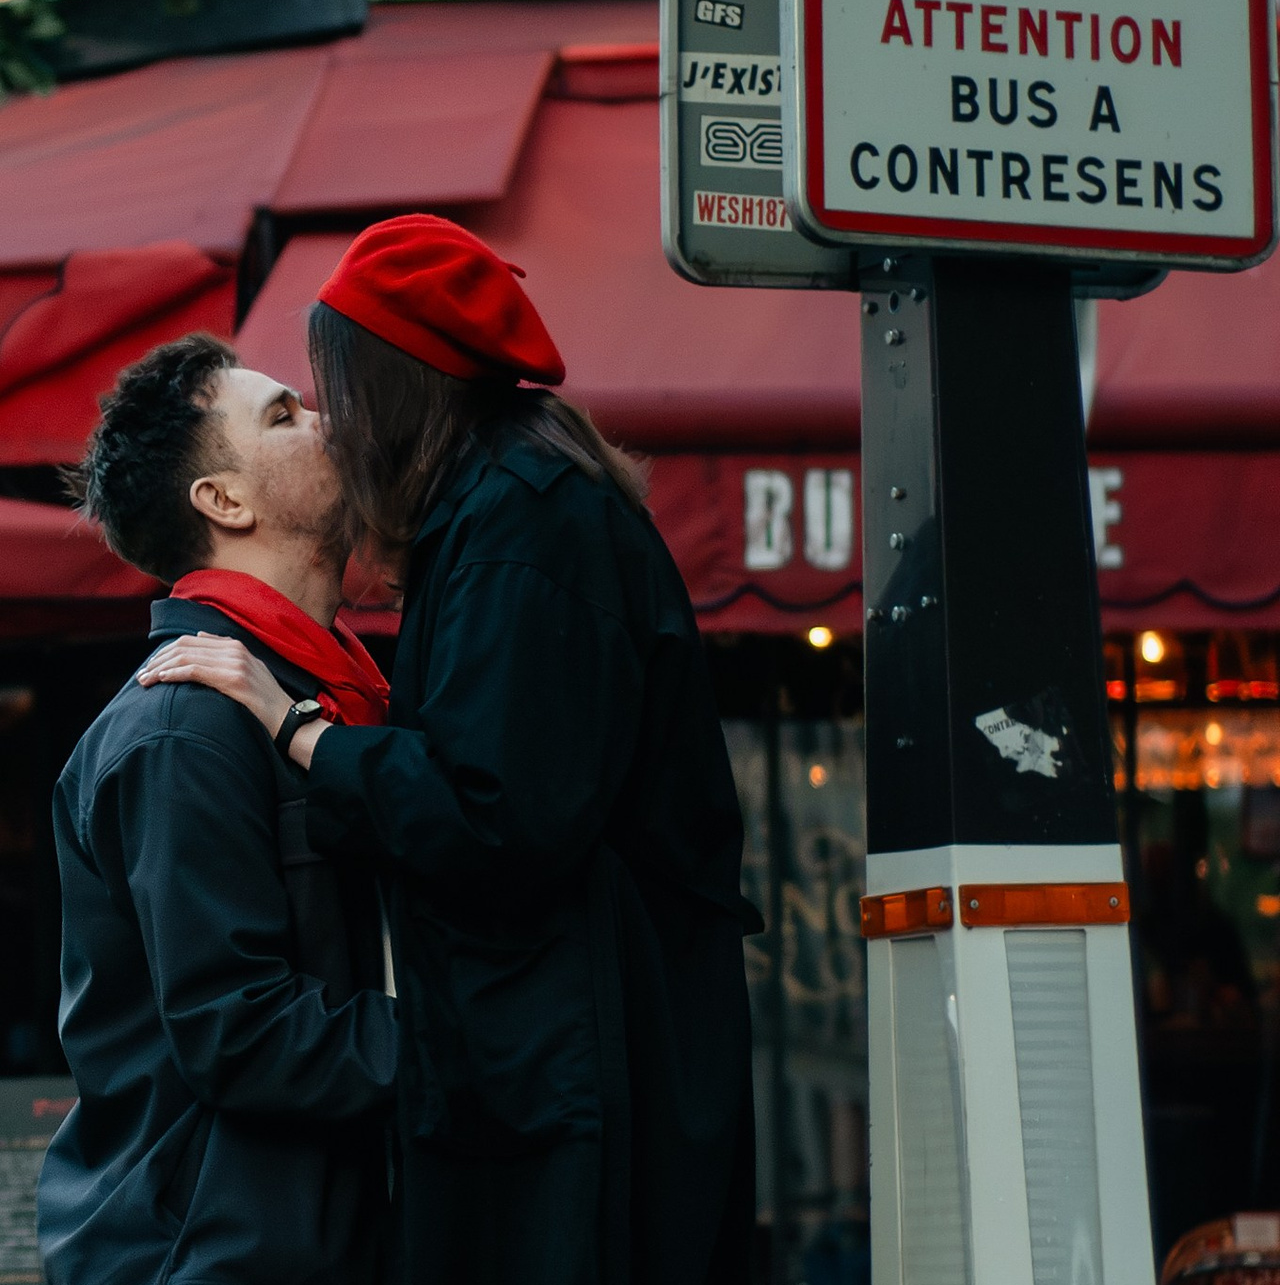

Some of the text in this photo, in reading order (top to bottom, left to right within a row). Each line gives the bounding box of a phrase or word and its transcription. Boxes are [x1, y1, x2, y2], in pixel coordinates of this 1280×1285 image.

[697, 0, 742, 27] GFS
[683, 61, 782, 96] J'EXIS
[951, 75, 1122, 134] BUS A
[850, 141, 1224, 212] CONTRESENS
[697, 193, 787, 228] WESH187
